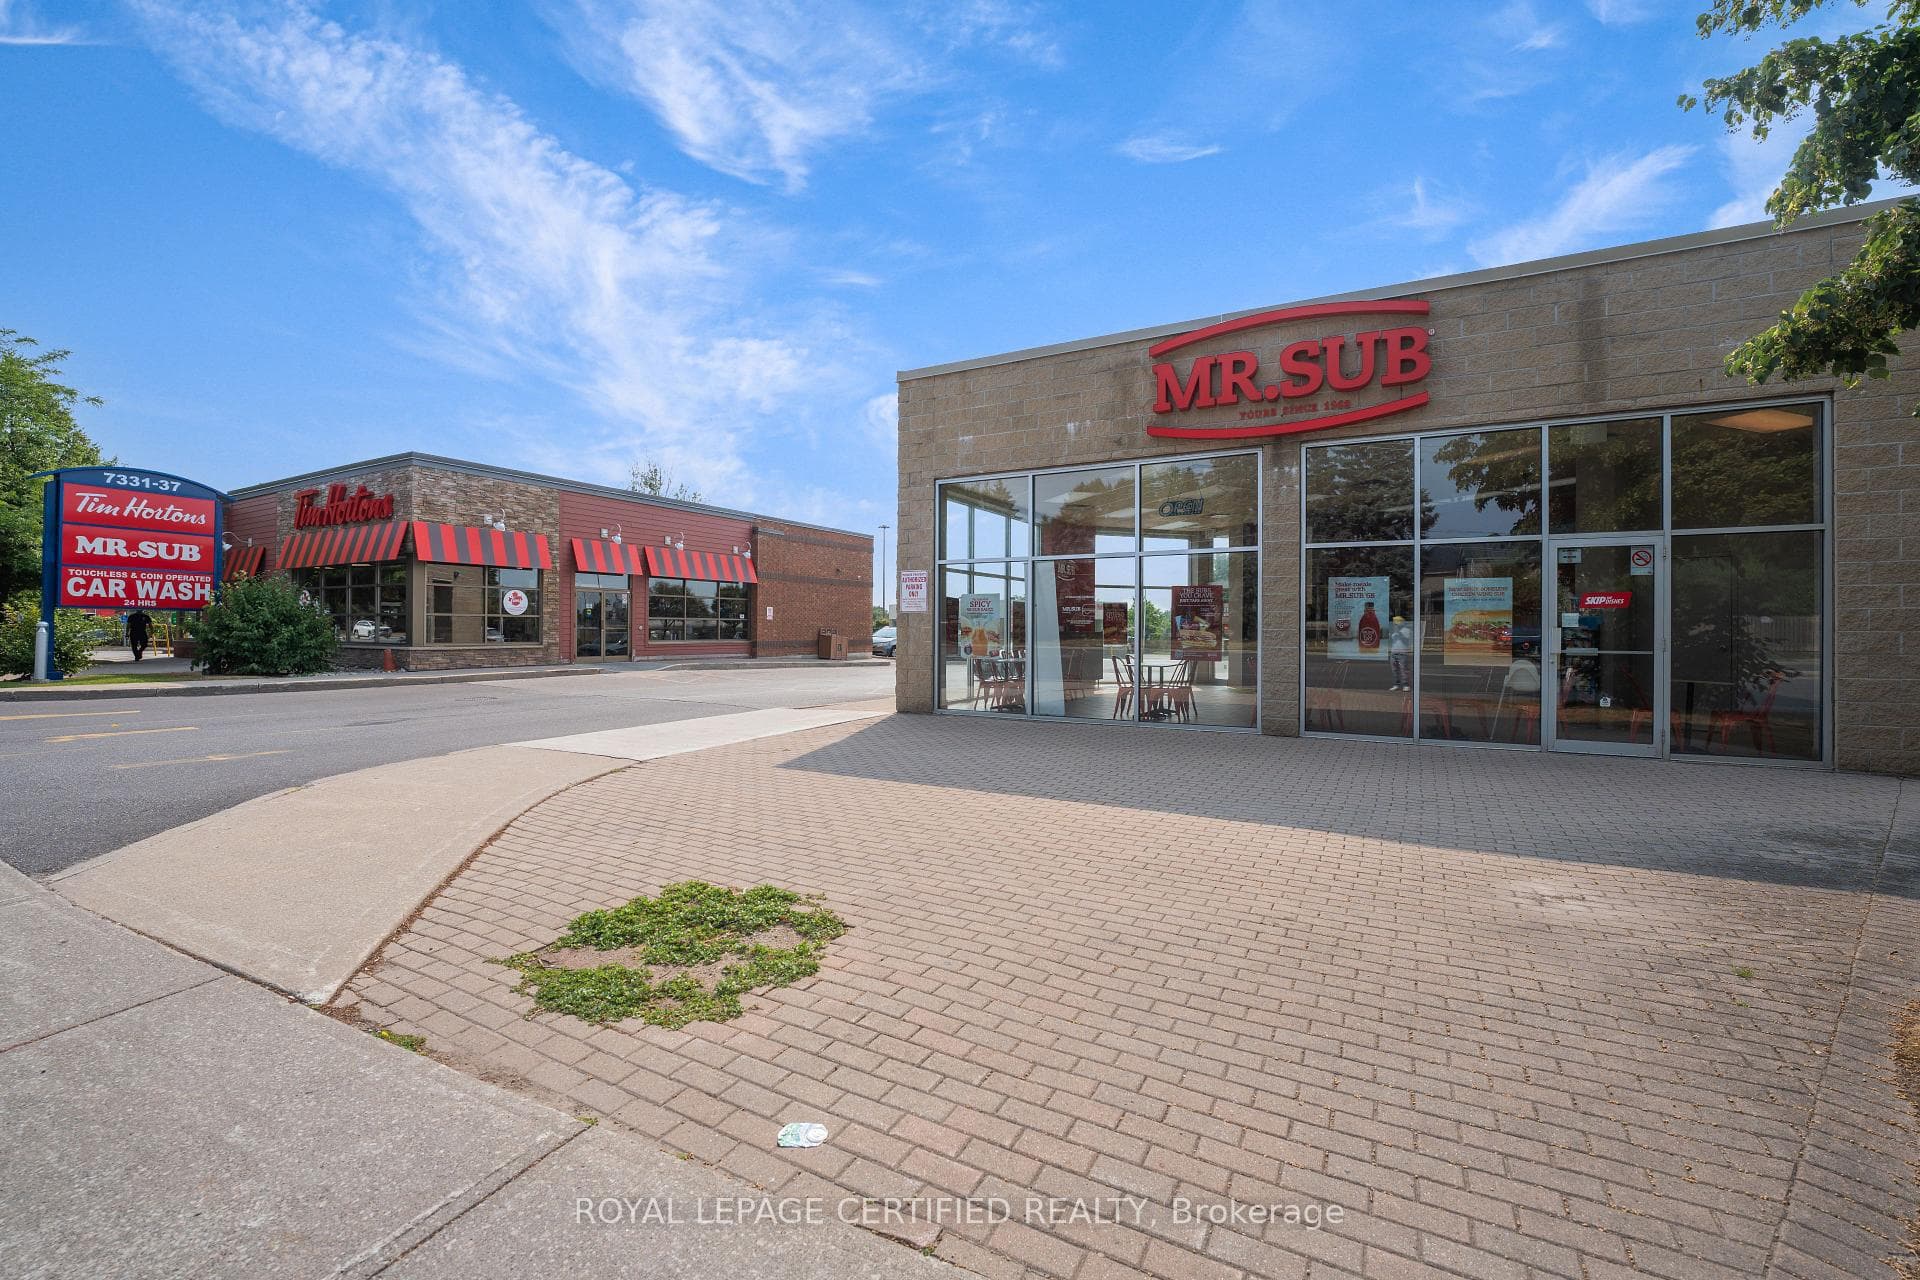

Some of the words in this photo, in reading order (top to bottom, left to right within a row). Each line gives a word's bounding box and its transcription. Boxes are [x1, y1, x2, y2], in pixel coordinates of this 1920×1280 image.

[1152, 326, 1432, 414] MR.SUB
[1239, 408, 1277, 420] YOURS
[1282, 403, 1318, 416] SINCE
[103, 472, 181, 492] 7331-37
[75, 492, 118, 516] Tim
[123, 496, 206, 525] Hortons
[294, 488, 325, 530] Tim
[323, 483, 395, 526] Hortons
[75, 535, 201, 562] MR.SUB
[68, 569, 128, 579] TOUCHLESS
[140, 572, 163, 580] COIN
[165, 574, 211, 583] OPERATED
[67, 577, 126, 599] CAR
[135, 579, 211, 601] WASH
[970, 600, 992, 608] SPICY
[1585, 596, 1606, 605] SKIP
